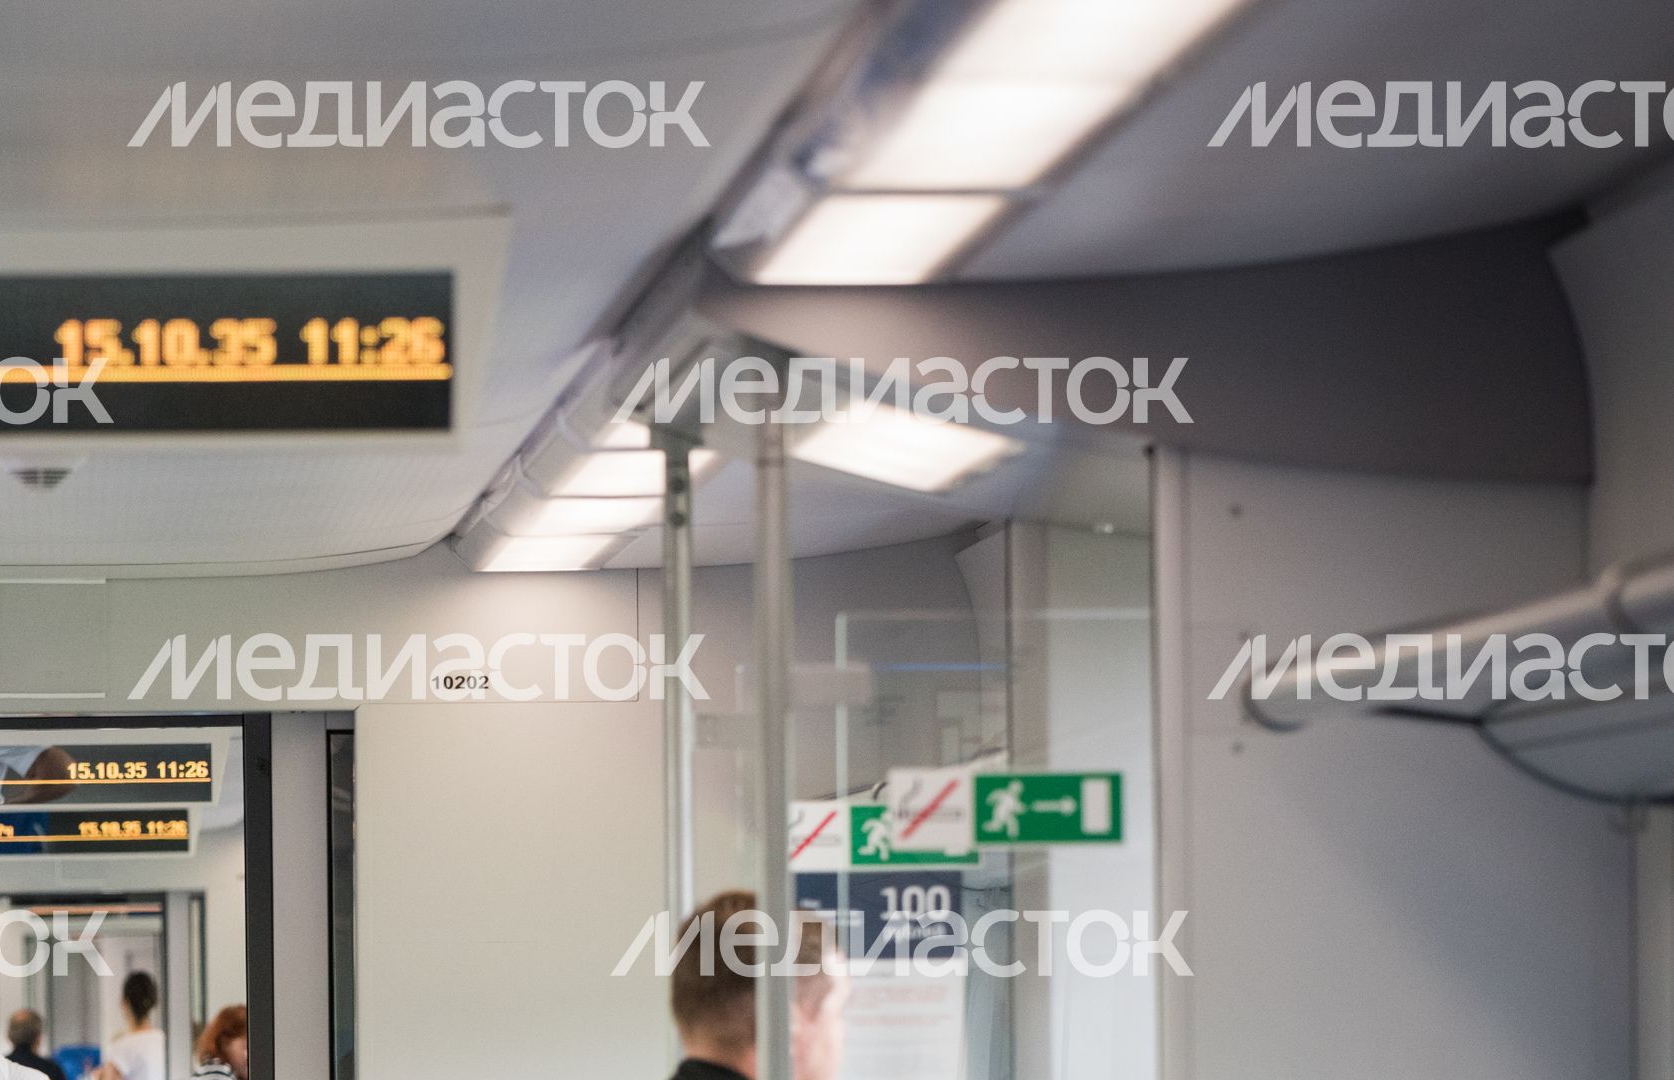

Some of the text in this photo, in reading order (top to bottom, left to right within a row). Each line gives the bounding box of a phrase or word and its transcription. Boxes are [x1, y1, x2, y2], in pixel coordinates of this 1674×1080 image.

[55, 317, 277, 366] 15.10.35
[301, 316, 445, 365] 11:26
[431, 675, 490, 690] 10202
[67, 761, 148, 779] 15.10.35
[157, 760, 209, 778] 11:26
[880, 885, 951, 920] 100
